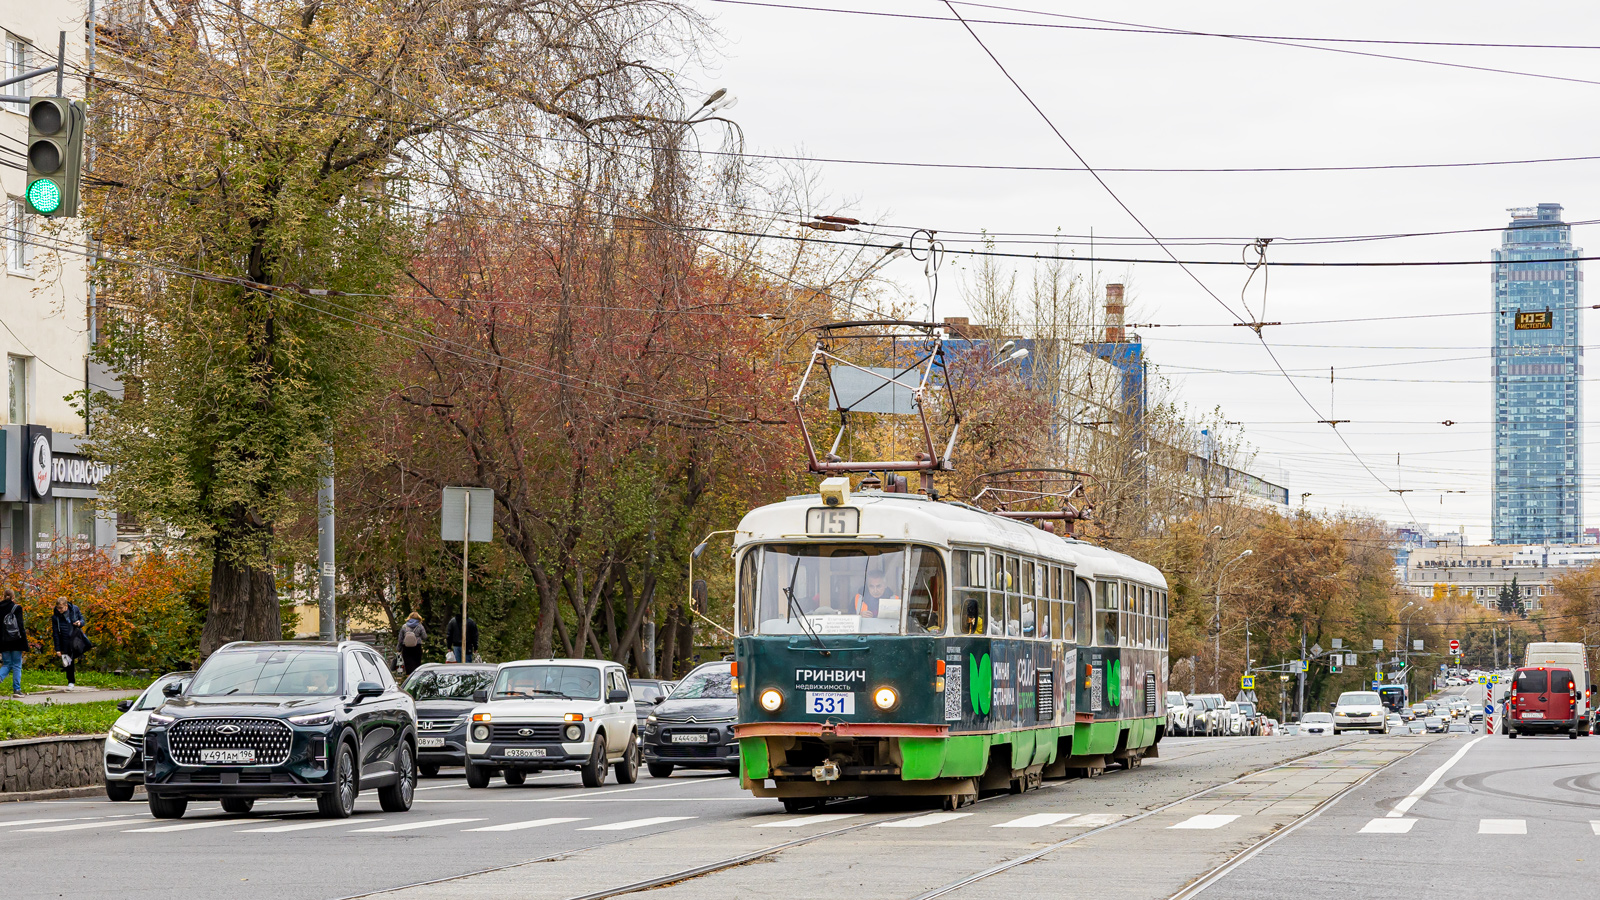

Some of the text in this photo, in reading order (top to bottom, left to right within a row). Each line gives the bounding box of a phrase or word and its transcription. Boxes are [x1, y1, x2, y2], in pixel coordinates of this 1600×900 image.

[816, 511, 846, 533] 15
[796, 669, 866, 682] ГРИНВИЧ
[814, 697, 845, 713] 531
[204, 751, 238, 760] У491АМ
